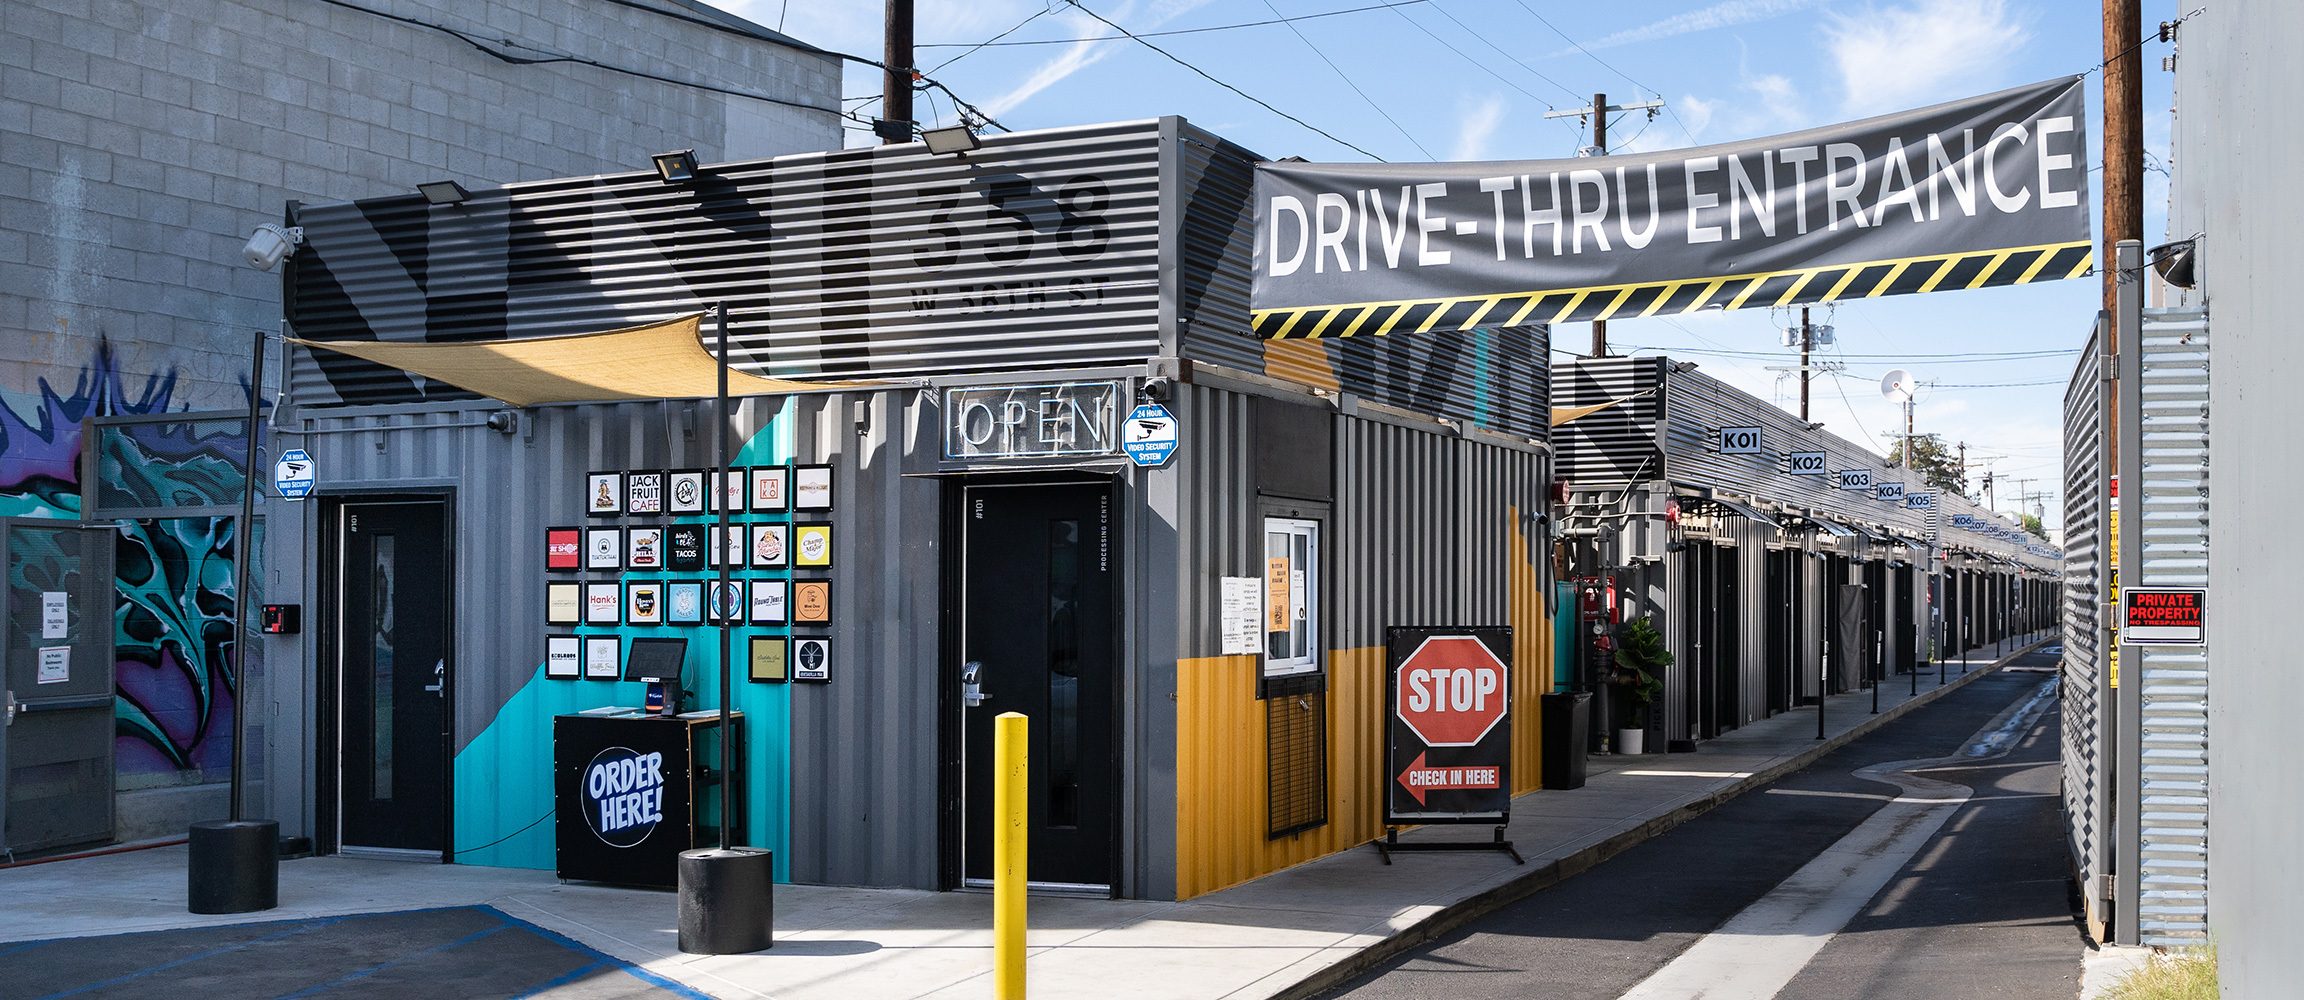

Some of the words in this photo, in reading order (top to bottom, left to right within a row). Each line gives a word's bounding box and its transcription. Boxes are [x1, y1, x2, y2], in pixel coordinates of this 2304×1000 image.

[1269, 163, 1660, 277] DRIVE-THRU
[1684, 115, 2078, 244] ENTRANCE
[913, 174, 1110, 273] 358
[911, 288, 938, 317] W
[959, 281, 1046, 315] 38TH
[1068, 276, 1110, 308] ST
[1137, 410, 1145, 418] 24
[1146, 409, 1163, 417] HOUR
[961, 396, 1100, 445] OPEN
[1127, 443, 1145, 451] VIDEO
[1145, 442, 1173, 450] SECURITY
[1724, 432, 1757, 449] K01
[1138, 452, 1162, 461] SYSTEM
[1793, 456, 1823, 470] K02
[631, 475, 659, 487] JACK
[1842, 474, 1869, 486] K03
[631, 487, 660, 499] FRUIT
[1879, 486, 1901, 497] K04
[630, 499, 659, 512] CAFE
[1908, 497, 1930, 506] K05
[975, 499, 984, 519] #101
[1954, 516, 1972, 525] K06
[1972, 522, 1986, 530] K07
[675, 550, 697, 558] TACOS
[590, 595, 617, 604] Hank's
[2136, 593, 2194, 607] PRIVATE
[2129, 606, 2200, 620] PROPERTY
[1408, 667, 1497, 713] STOP
[589, 751, 664, 800] ORDER
[1409, 769, 1448, 786] CHECK
[1450, 769, 1462, 785] IN
[1465, 769, 1495, 785] HERE
[601, 785, 664, 833] HERE!
